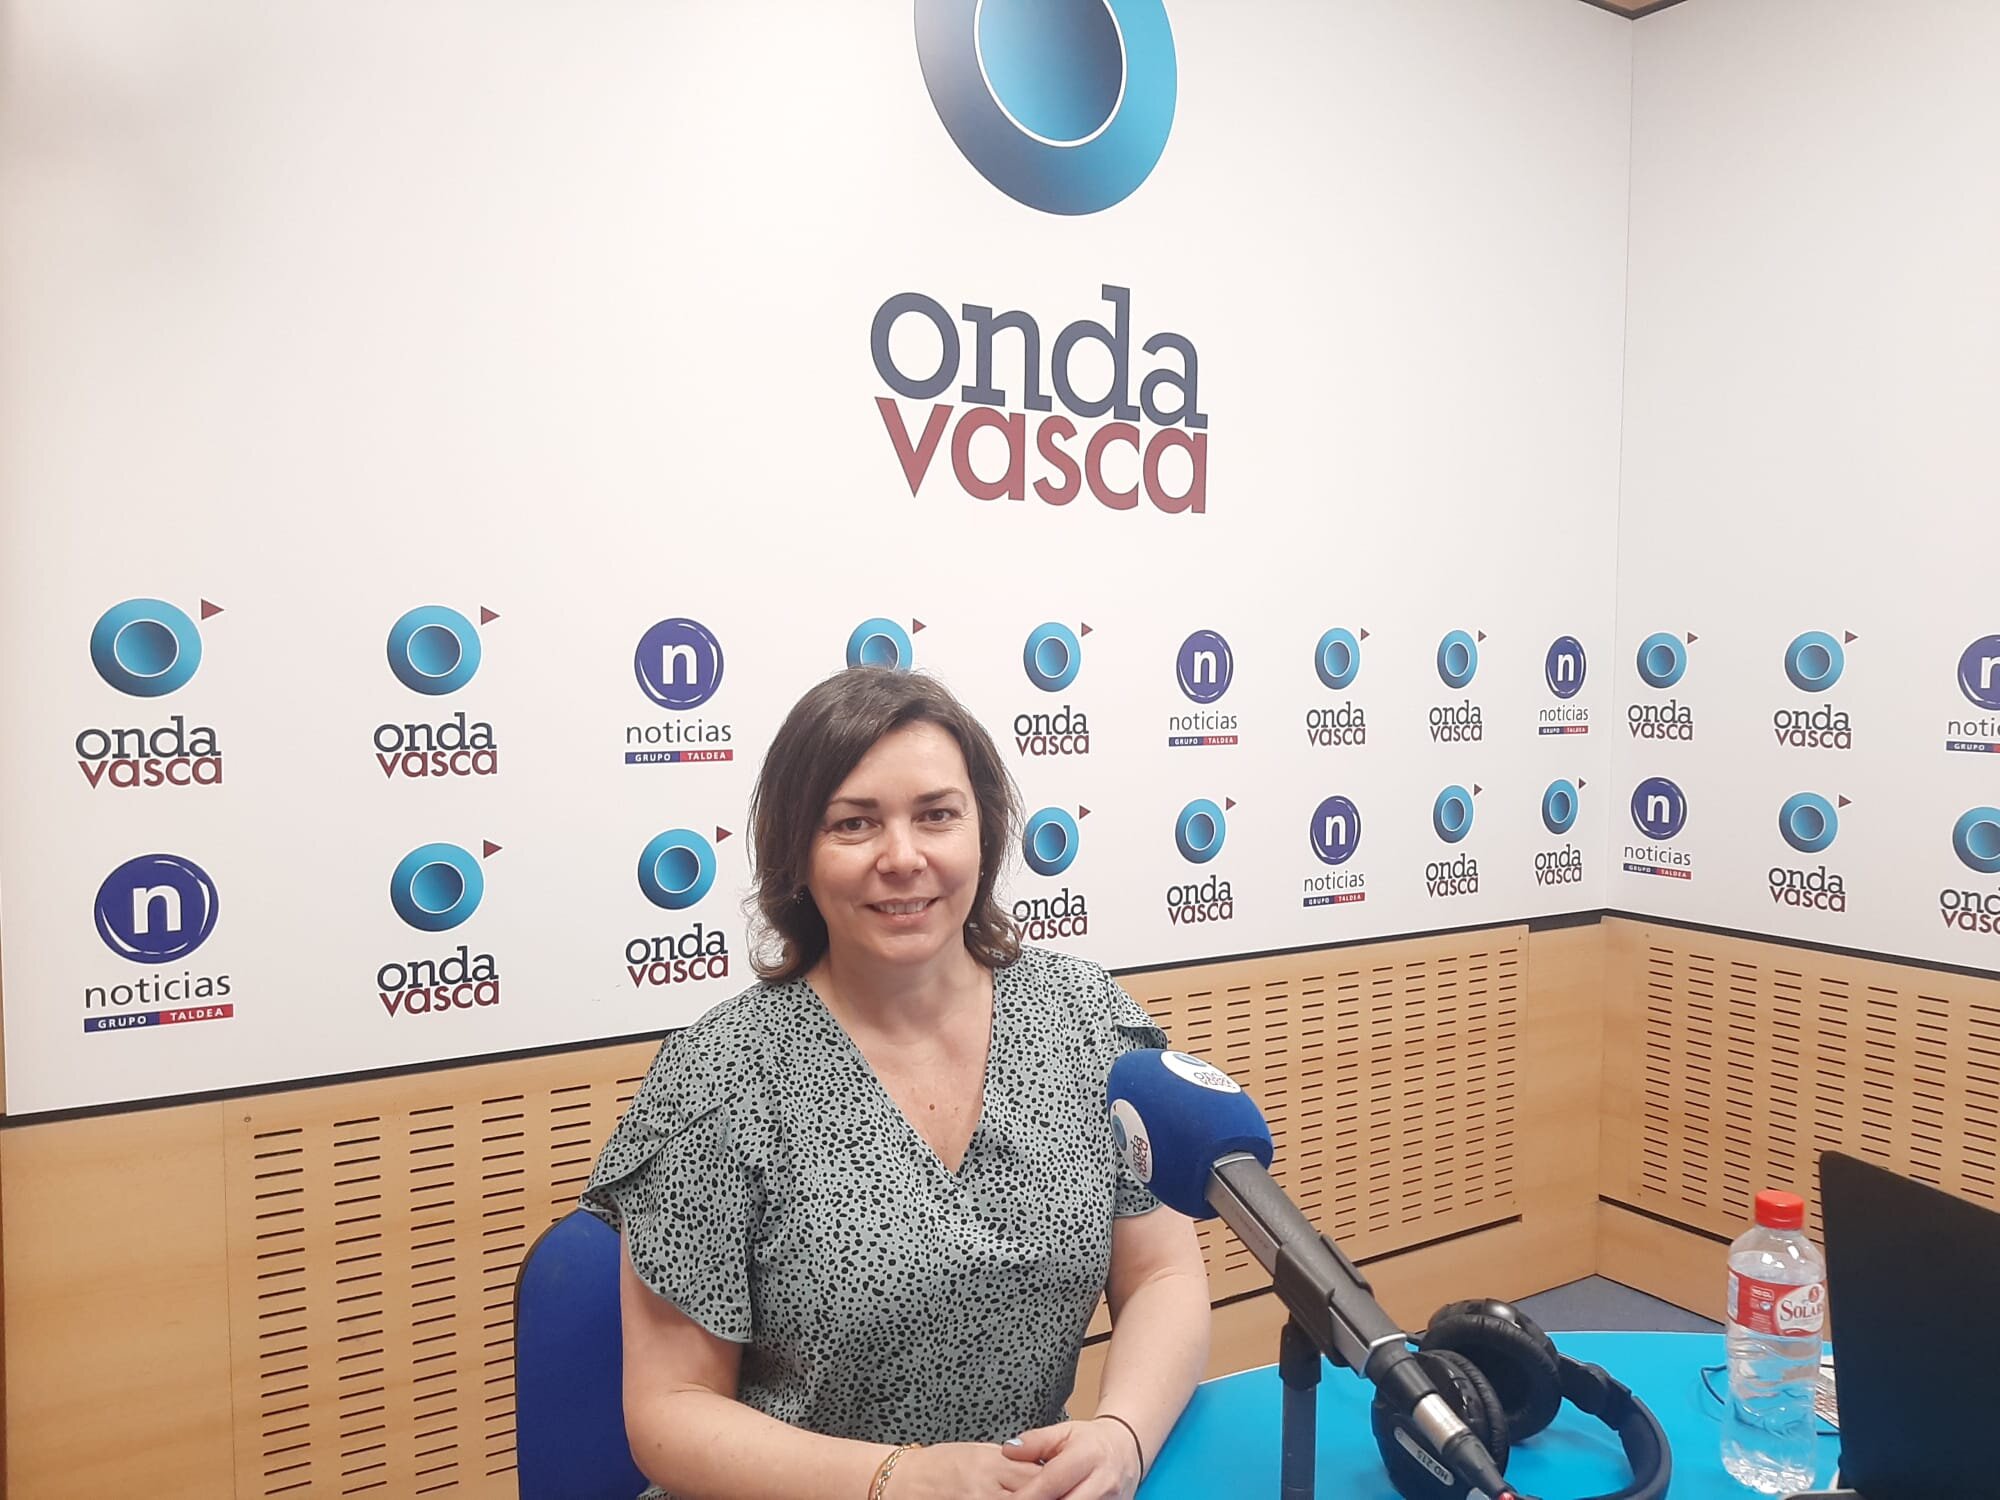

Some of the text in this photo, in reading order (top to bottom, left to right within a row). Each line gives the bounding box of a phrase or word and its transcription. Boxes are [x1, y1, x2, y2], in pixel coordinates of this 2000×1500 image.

[870, 283, 1208, 429] onda
[874, 396, 1208, 514] vasca
[663, 644, 698, 684] n
[1193, 651, 1217, 683] n
[1557, 654, 1574, 682] n
[1014, 704, 1089, 736] onda
[1169, 710, 1237, 731] noticias
[1306, 700, 1365, 728] onda
[1429, 699, 1482, 725] onda
[1539, 704, 1589, 721] noticias
[1627, 699, 1693, 724] onda
[1773, 704, 1851, 732] onda
[75, 715, 222, 760] onda
[373, 711, 497, 752] onda
[626, 719, 732, 744] noticias
[1307, 727, 1366, 747] vasca
[1430, 724, 1483, 743] vasca
[1629, 721, 1693, 741] vasca
[1774, 728, 1852, 749] vasca
[1948, 717, 2000, 737] noti
[635, 751, 726, 762] GRUPO TALDEA
[1015, 735, 1089, 757] vasca
[1953, 743, 1985, 751] GRUPO
[78, 757, 222, 789] vasca
[375, 750, 498, 779] vasca
[1647, 795, 1670, 824] n
[1325, 815, 1347, 846] n
[1425, 853, 1479, 881] onda
[1534, 843, 1583, 870] onda
[1623, 845, 1691, 866] noticias
[1166, 874, 1233, 907] onda
[1304, 870, 1365, 892] noticias
[1426, 876, 1479, 898] vasca
[1535, 866, 1583, 887] vasca
[1768, 866, 1846, 896] onda
[132, 885, 182, 934] n
[1012, 888, 1087, 922] onda
[1769, 885, 1847, 912] vasca
[1167, 901, 1233, 926] vasca
[1013, 916, 1088, 942] vasca
[625, 922, 728, 965] onda
[377, 945, 499, 991] onda
[627, 955, 729, 989] vasca
[85, 971, 231, 1009] noticias
[379, 980, 499, 1018] vasca
[98, 1007, 224, 1029] GRUPO TALDEA
